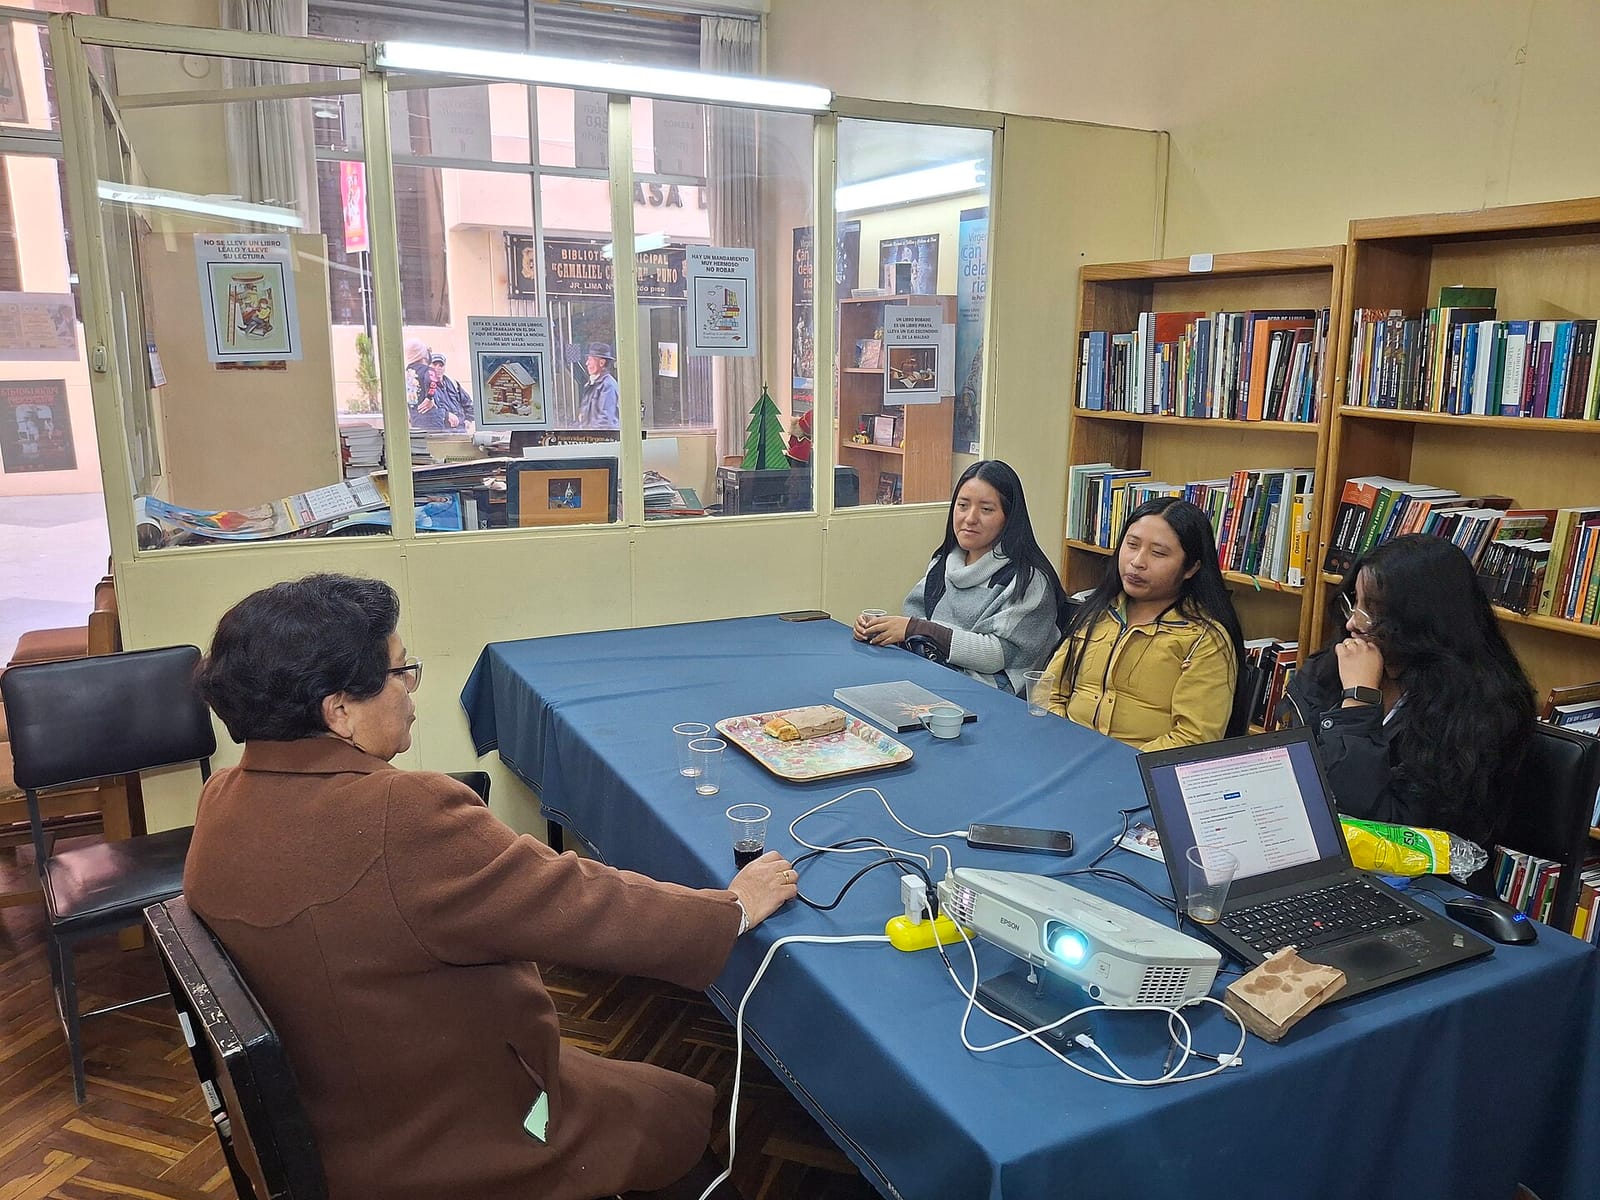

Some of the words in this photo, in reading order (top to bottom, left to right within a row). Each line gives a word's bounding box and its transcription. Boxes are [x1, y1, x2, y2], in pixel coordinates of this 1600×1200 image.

[633, 182, 683, 208] ASA
[656, 268, 678, 283] PUNO
[650, 286, 665, 294] piso
[1403, 831, 1415, 846] 50
[1000, 917, 1020, 931] EPSON
